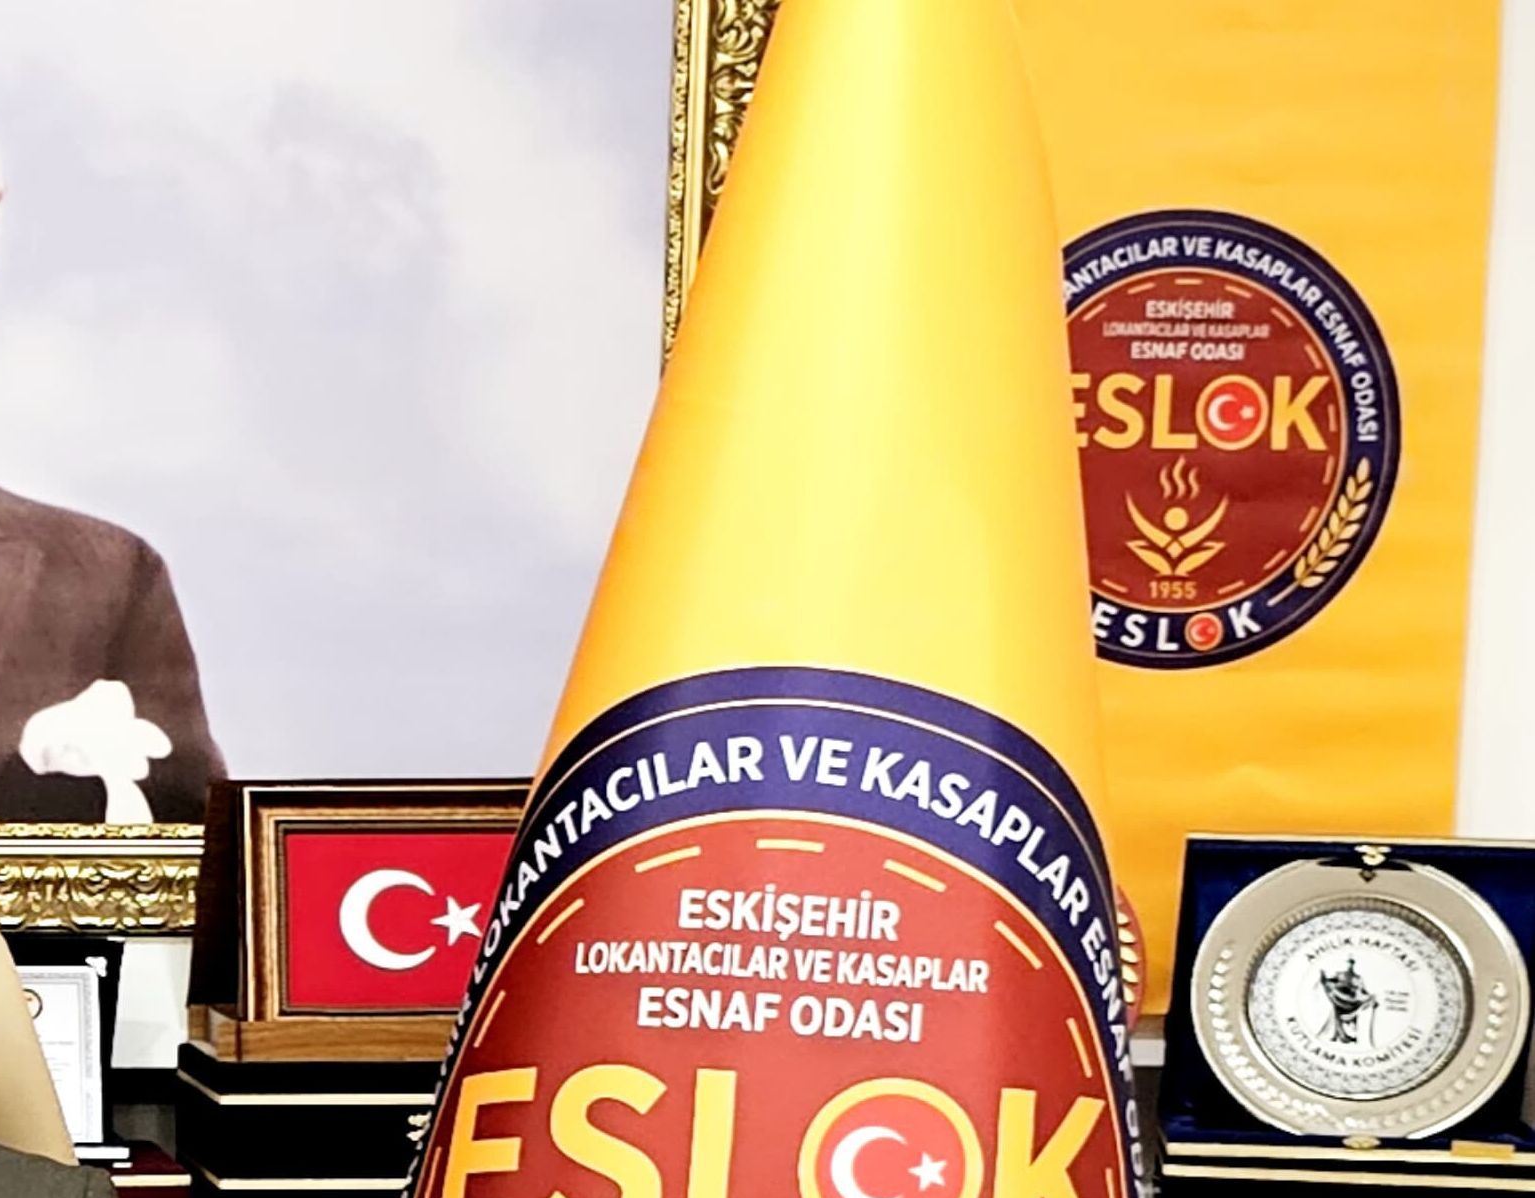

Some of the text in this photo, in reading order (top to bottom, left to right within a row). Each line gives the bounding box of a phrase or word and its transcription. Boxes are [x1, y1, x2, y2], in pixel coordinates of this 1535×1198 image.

[1130, 341, 1245, 360] ESNAF ODASI
[1182, 236, 1212, 258] VE
[1215, 239, 1322, 308] KASAPLAR
[1315, 301, 1368, 368] ESNAF
[1351, 371, 1379, 442] ODASI
[1149, 580, 1198, 600] 1955
[473, 735, 764, 984] LOKANTACILAR
[779, 735, 853, 786] VE
[860, 747, 1090, 926] KASAPLAR
[677, 883, 902, 942] ESKİŞEHİR
[574, 941, 991, 993] LOKANTACILAR VE KASAPLAR
[636, 986, 925, 1043] ESNAF ODASI
